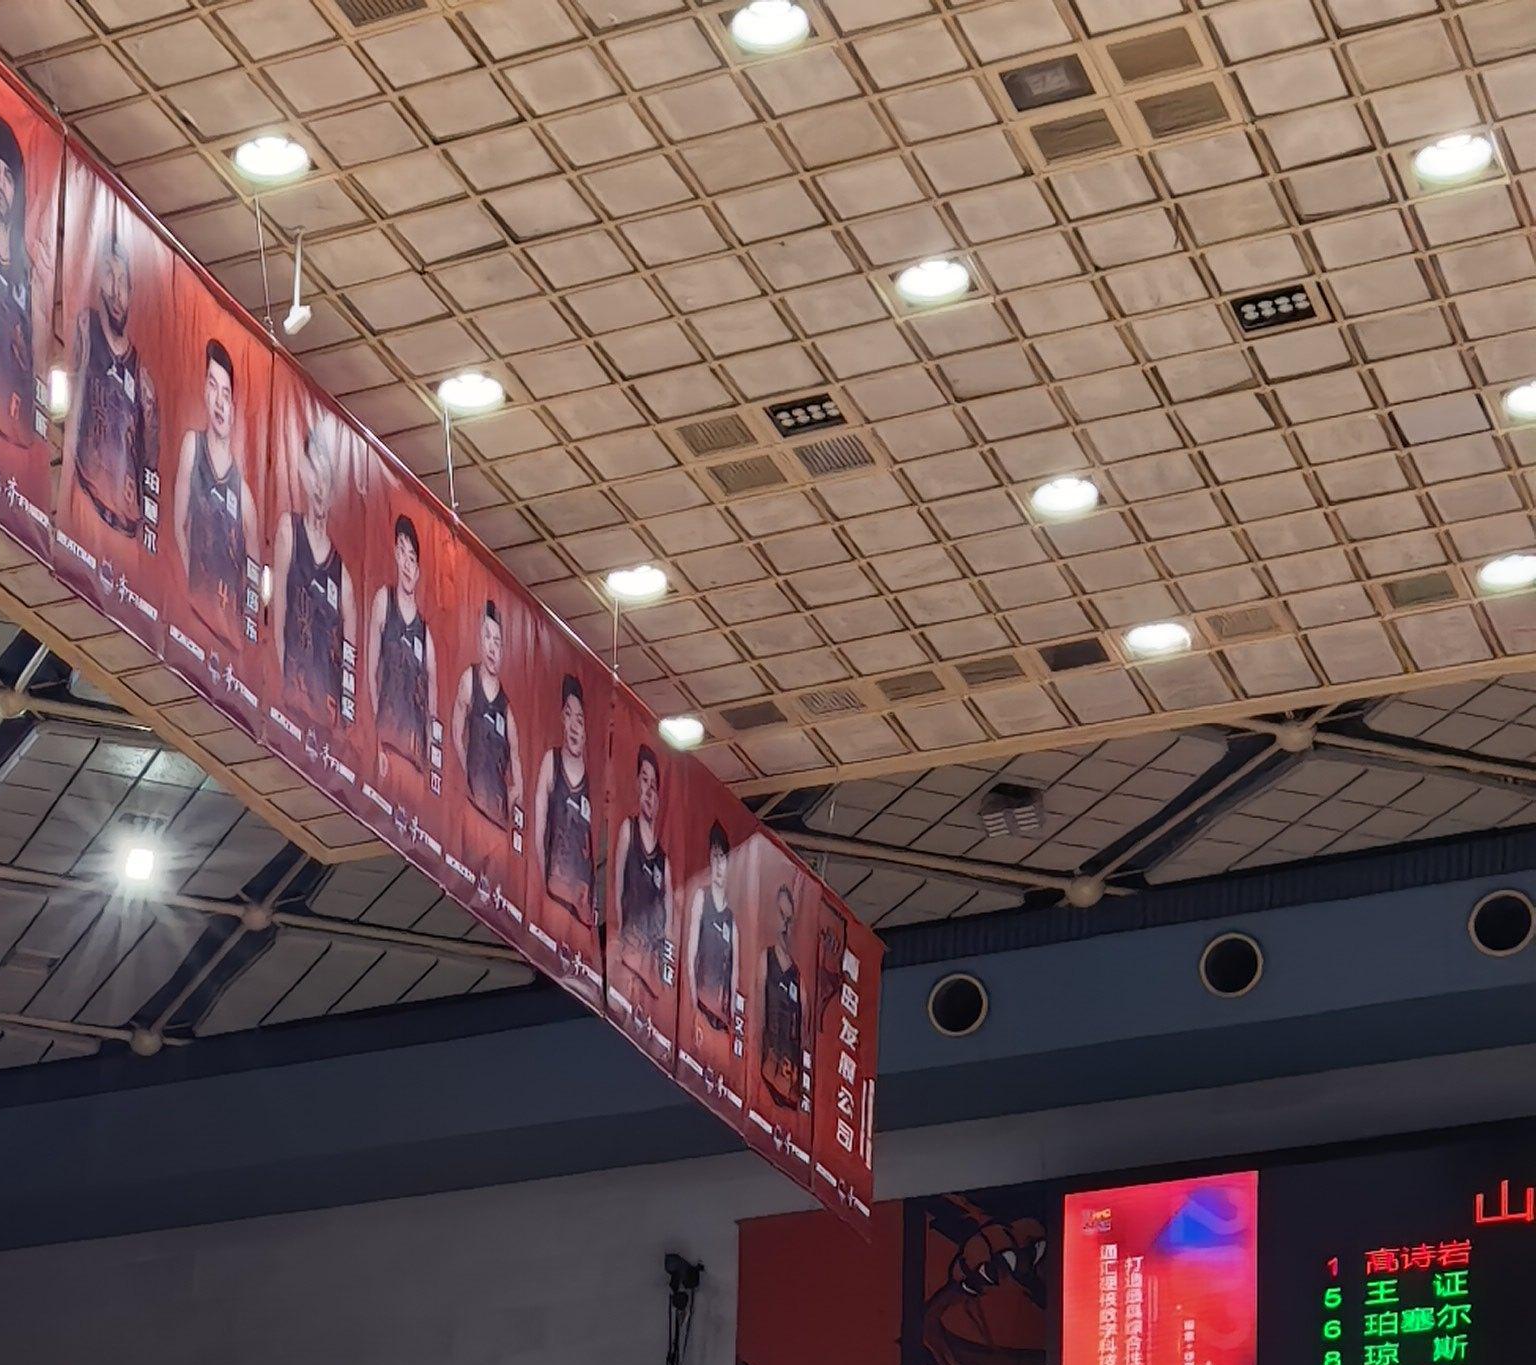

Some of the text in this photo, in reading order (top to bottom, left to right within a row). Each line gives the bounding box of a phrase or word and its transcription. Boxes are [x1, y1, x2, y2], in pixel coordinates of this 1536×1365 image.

[1475, 1179, 1535, 1224] 山
[1327, 1239, 1472, 1278] 1 高诗岩
[1324, 1287, 1342, 1308] 5
[1324, 1320, 1341, 1339] 6
